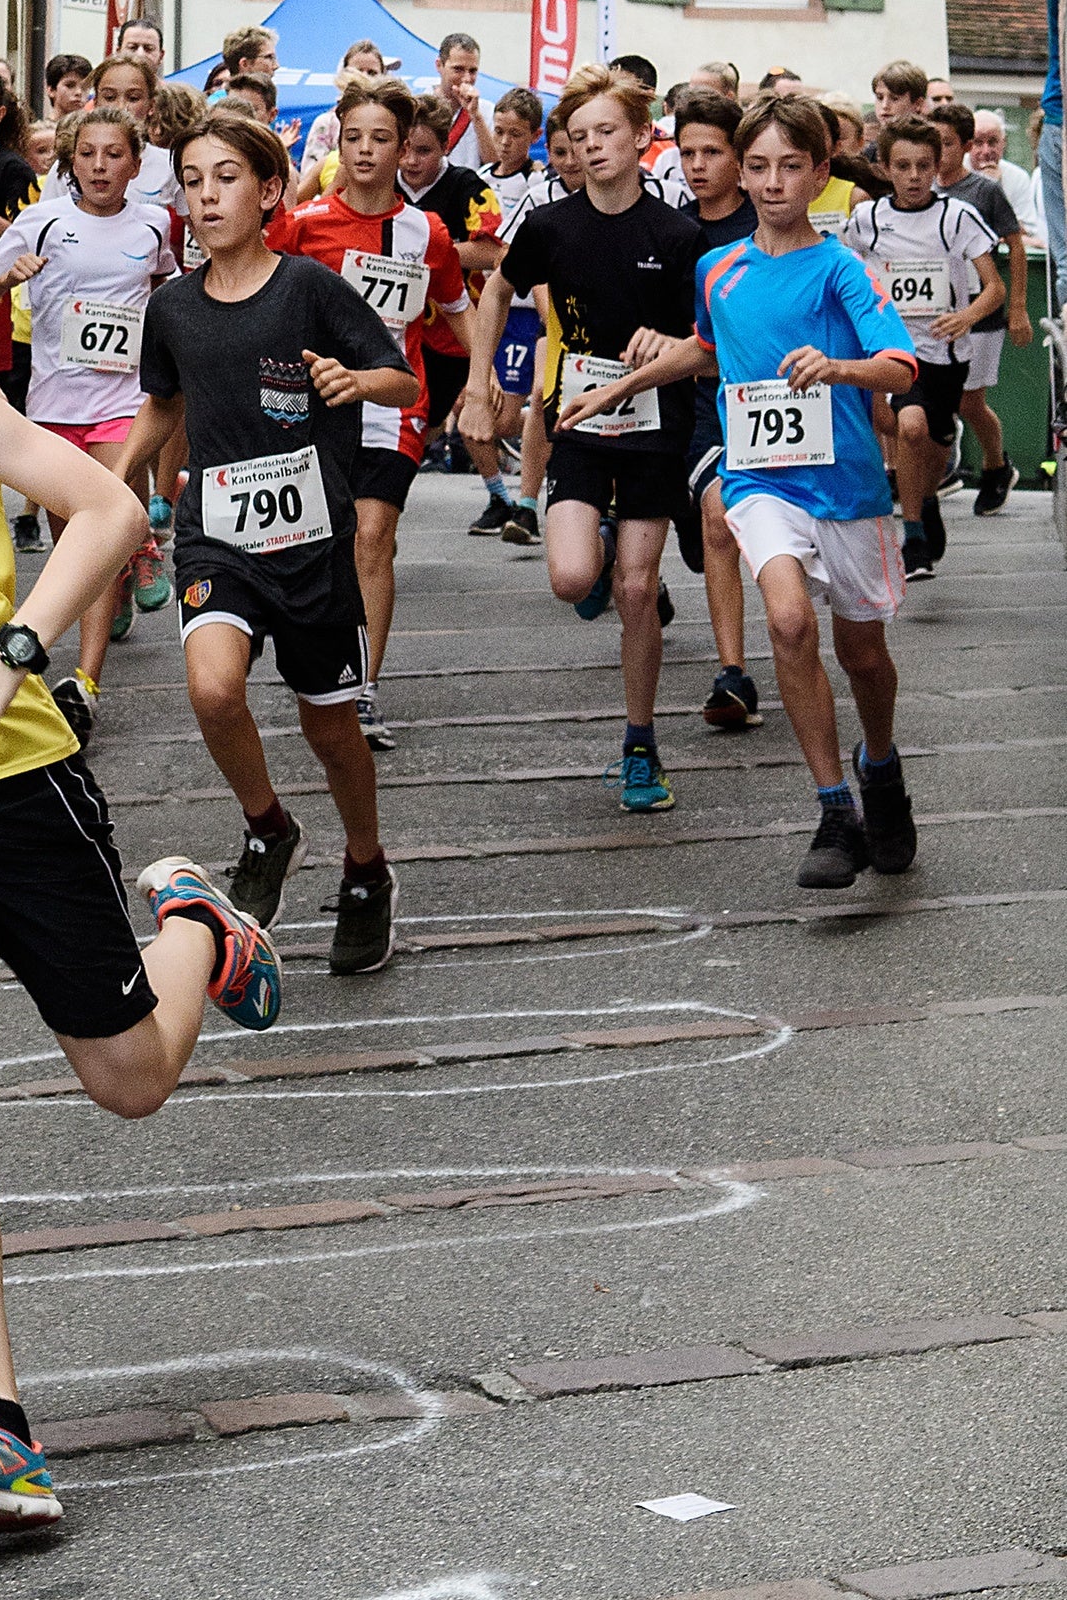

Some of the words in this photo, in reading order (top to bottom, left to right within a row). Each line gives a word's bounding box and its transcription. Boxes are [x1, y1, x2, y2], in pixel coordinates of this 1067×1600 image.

[366, 263, 422, 280] Kantonalbank
[361, 275, 409, 312] 771
[891, 277, 934, 302] 694
[85, 308, 140, 323] Kantonalbank
[80, 322, 129, 356] 672
[505, 344, 528, 368] 17
[748, 390, 821, 402] Kantonalbank
[748, 407, 805, 447] 793
[231, 461, 311, 486] Kantonalbank
[230, 484, 303, 534] 790
[265, 531, 307, 547] STADTLAUF
[307, 526, 324, 539] 2017
